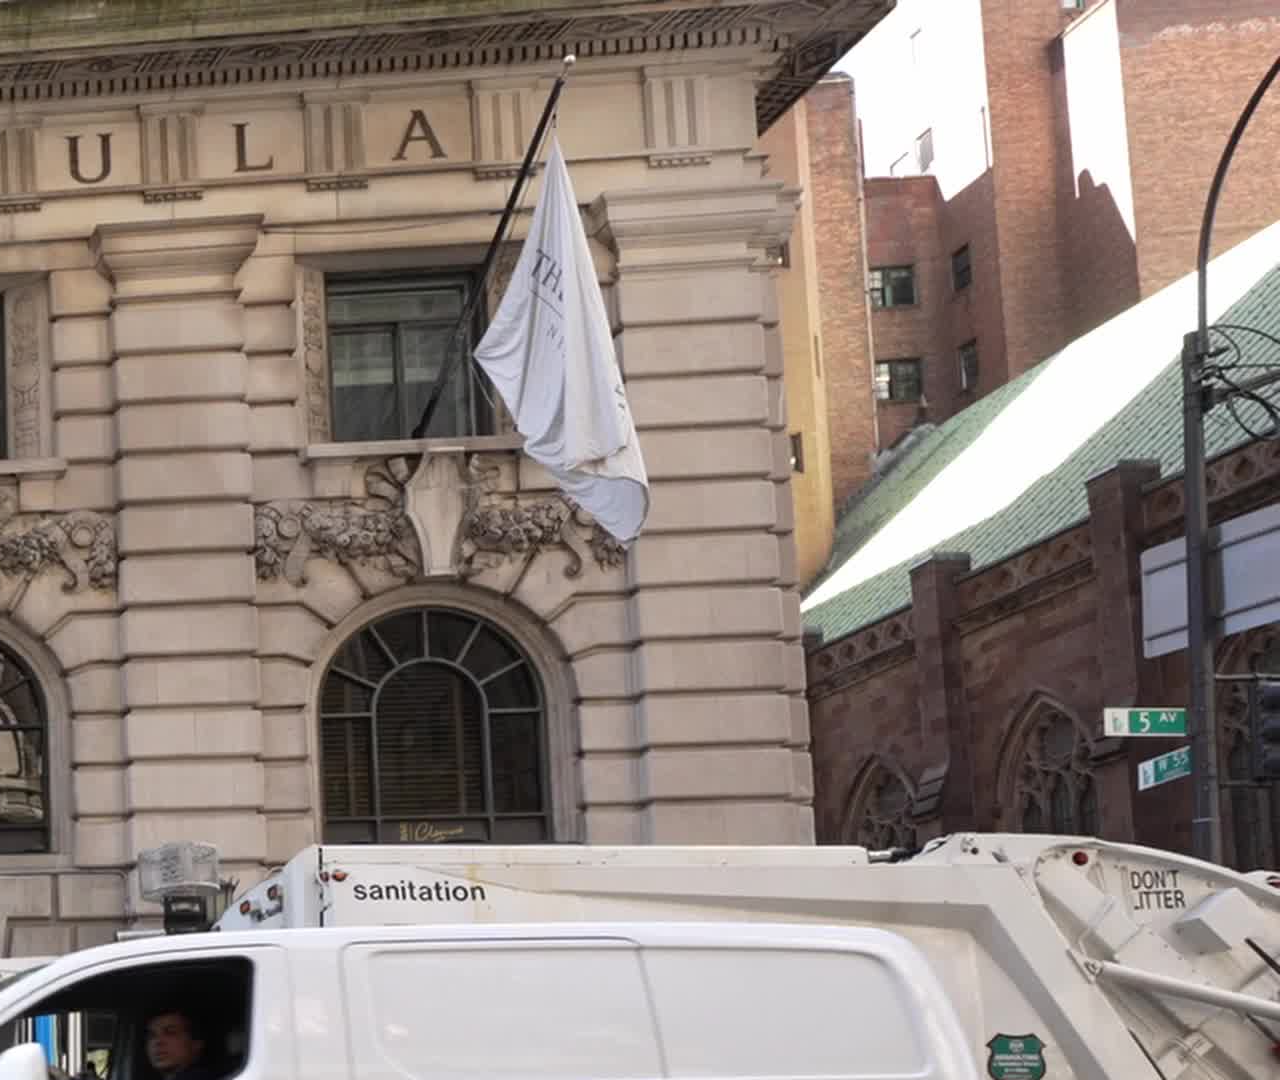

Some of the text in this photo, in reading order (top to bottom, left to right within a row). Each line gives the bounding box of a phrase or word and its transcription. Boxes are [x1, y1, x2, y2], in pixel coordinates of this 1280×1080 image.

[1138, 711, 1177, 732] 5 AV
[352, 881, 487, 903] sanitation
